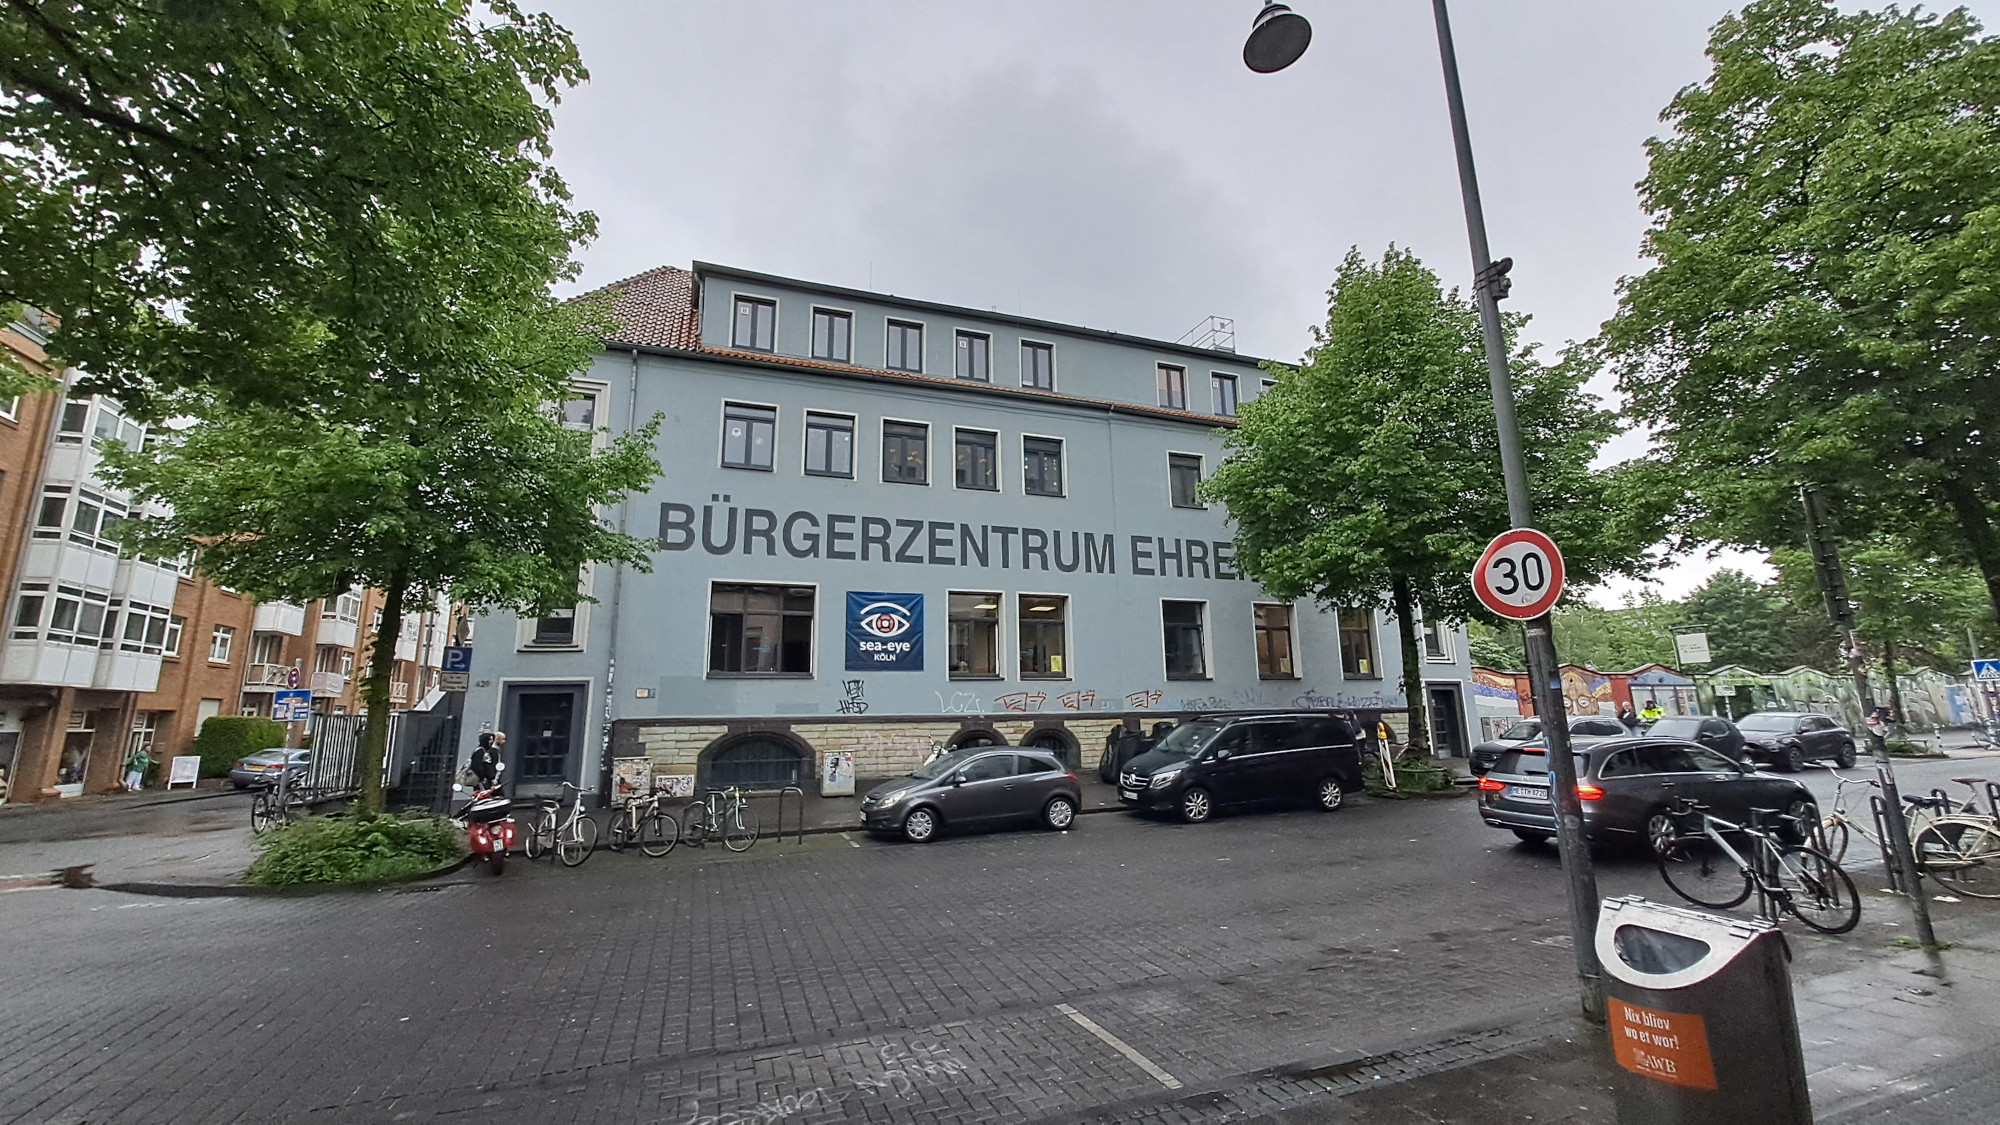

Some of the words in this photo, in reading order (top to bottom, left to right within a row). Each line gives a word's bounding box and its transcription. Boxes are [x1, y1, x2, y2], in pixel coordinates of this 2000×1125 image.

[659, 494, 1115, 575] BÜRGERZENTRUM
[1131, 535, 1245, 581] EHRE
[1492, 552, 1545, 596] 30
[860, 641, 911, 653] sea-eye
[874, 652, 896, 661] KÖLN
[446, 649, 463, 669] P
[1624, 1006, 1642, 1024] Nix
[1642, 1011, 1671, 1031] bliev
[1624, 1026, 1638, 1040] wo
[1640, 1031, 1651, 1044] et
[1652, 1035, 1680, 1050] wor!
[1646, 1055, 1677, 1073] AWB
